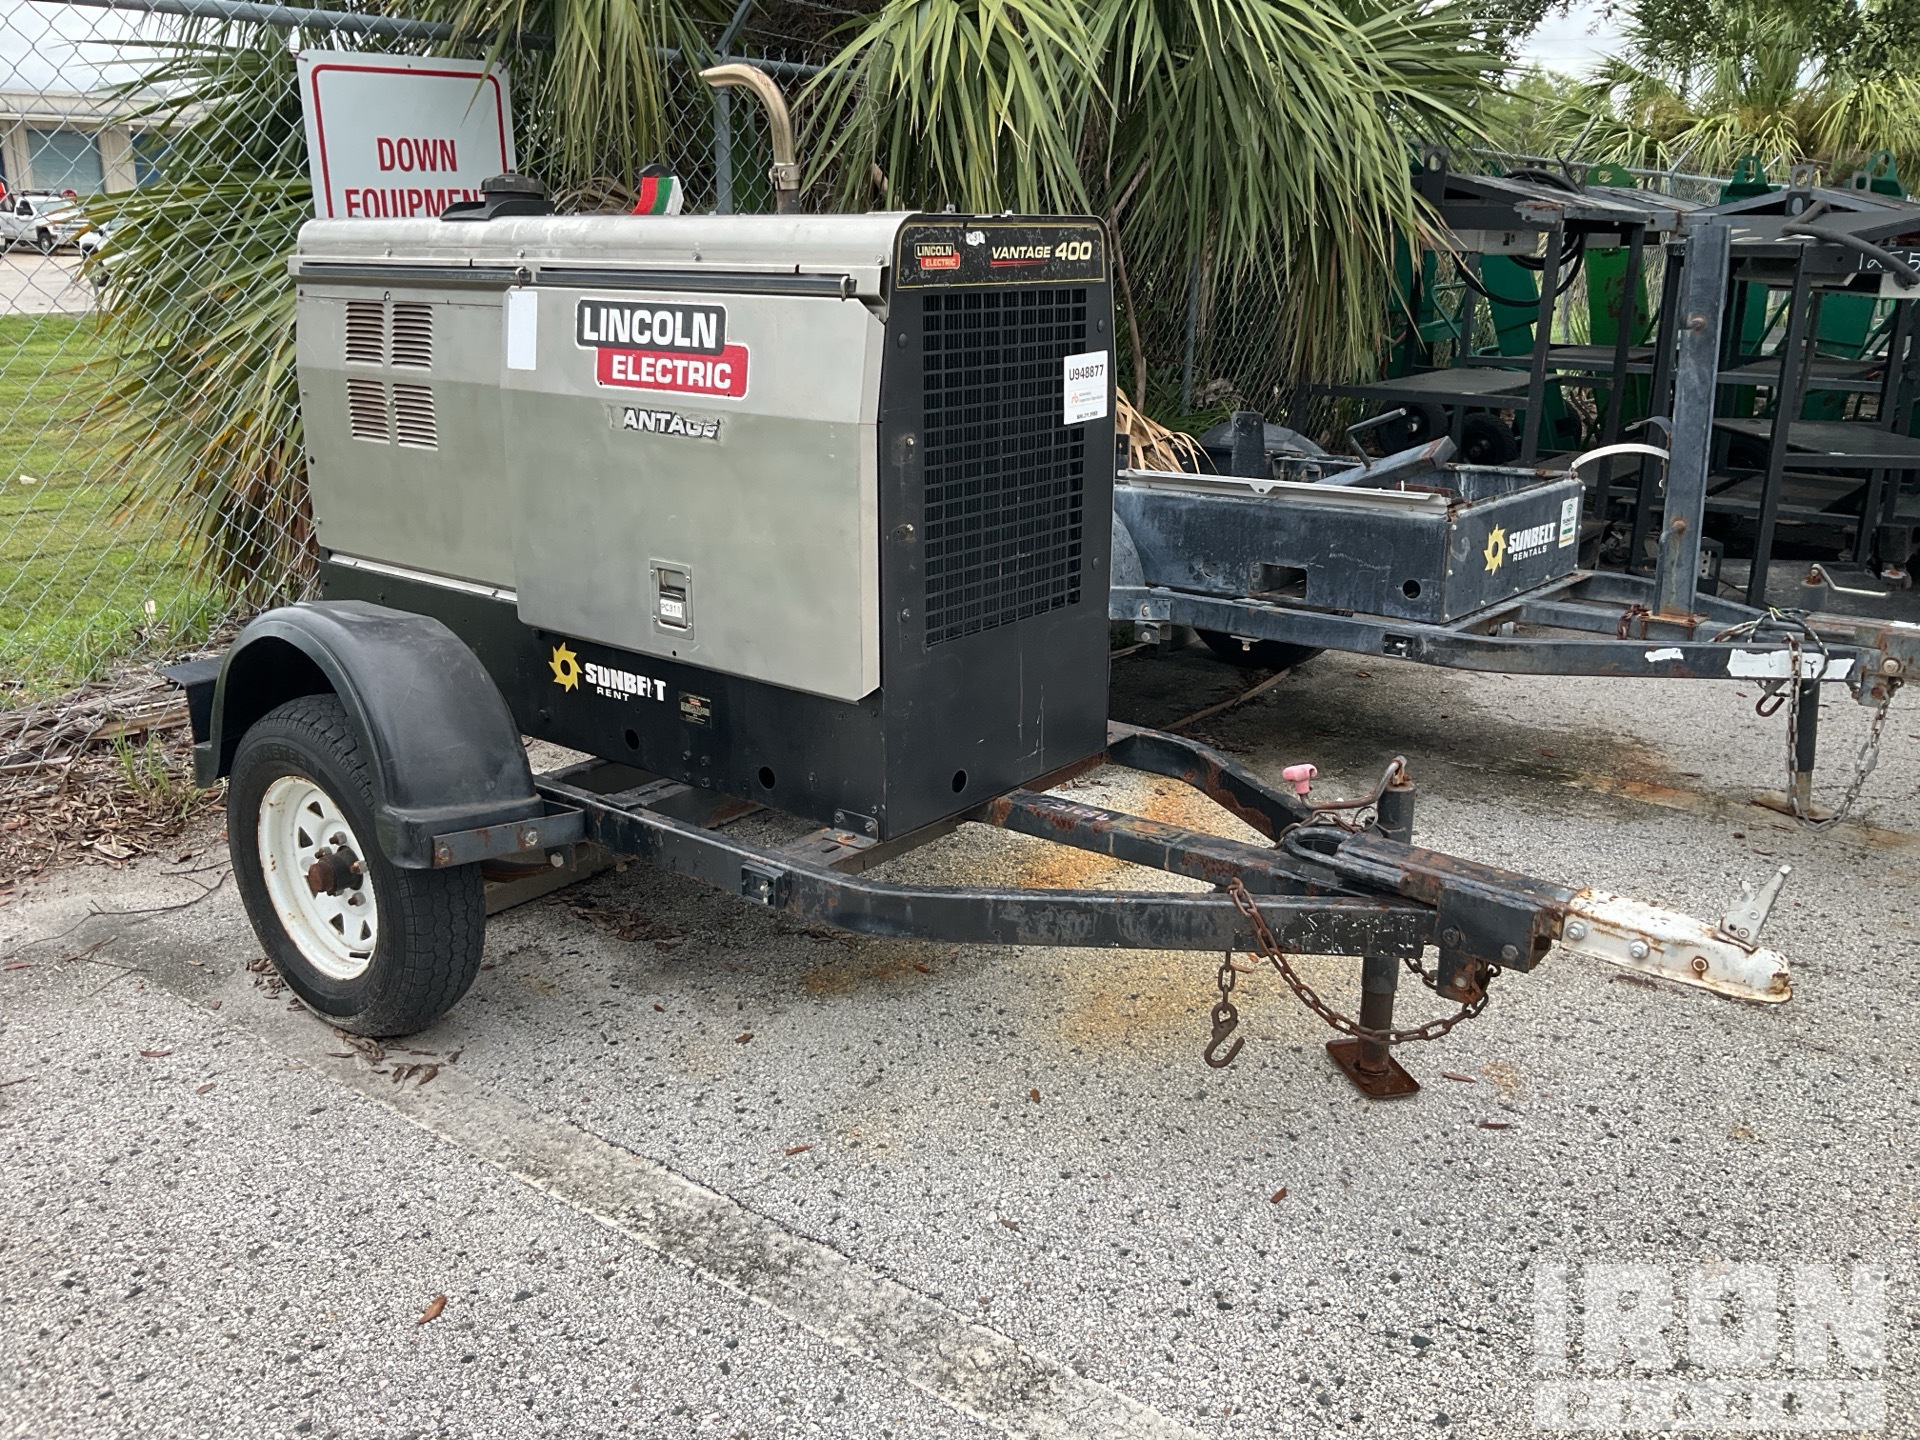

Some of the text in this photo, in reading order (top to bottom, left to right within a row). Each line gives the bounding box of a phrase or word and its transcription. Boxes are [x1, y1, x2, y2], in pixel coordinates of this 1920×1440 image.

[377, 138, 457, 171] DOWN
[345, 188, 487, 217] EQUIPM
[917, 245, 952, 257] LINCOLN
[925, 258, 956, 267] ELECTRIC
[991, 241, 1092, 261] VANTAGE 400
[583, 307, 717, 348] LINCOLN
[612, 354, 732, 389] ELECTRIC
[1068, 364, 1104, 381] U948877
[1507, 522, 1556, 554] SUNBELT
[1512, 544, 1548, 562] RENTALS
